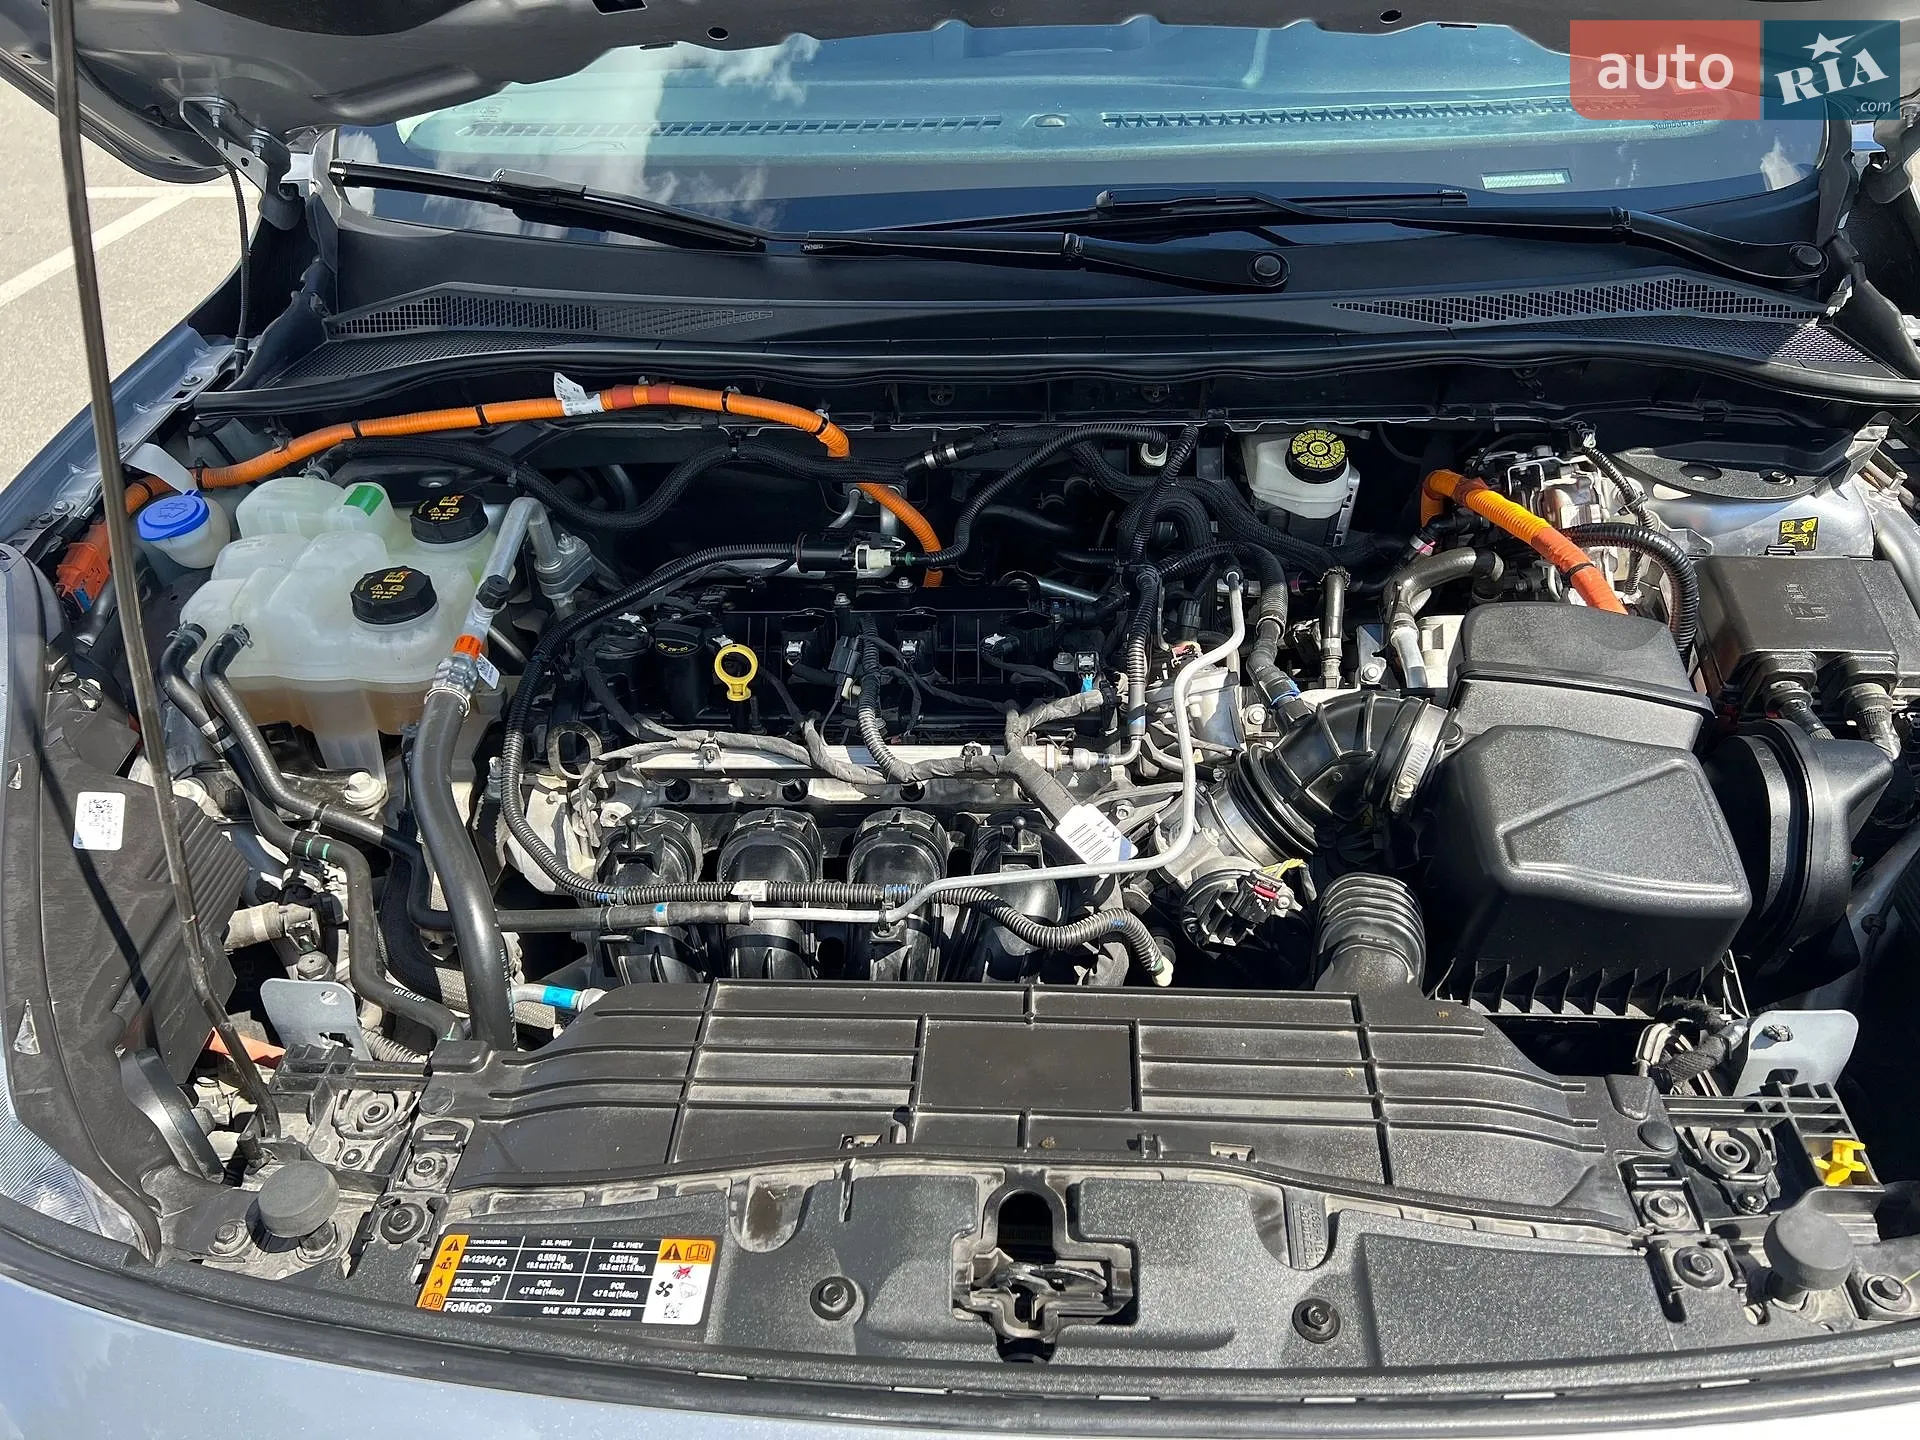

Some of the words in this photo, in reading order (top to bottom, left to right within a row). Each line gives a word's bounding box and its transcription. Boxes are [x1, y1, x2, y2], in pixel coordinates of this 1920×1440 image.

[453, 1278, 474, 1287] POE
[537, 1279, 552, 1287] POE
[610, 1282, 626, 1290] POE
[443, 1301, 493, 1313] FoMoCo
[542, 1306, 560, 1315] SAE
